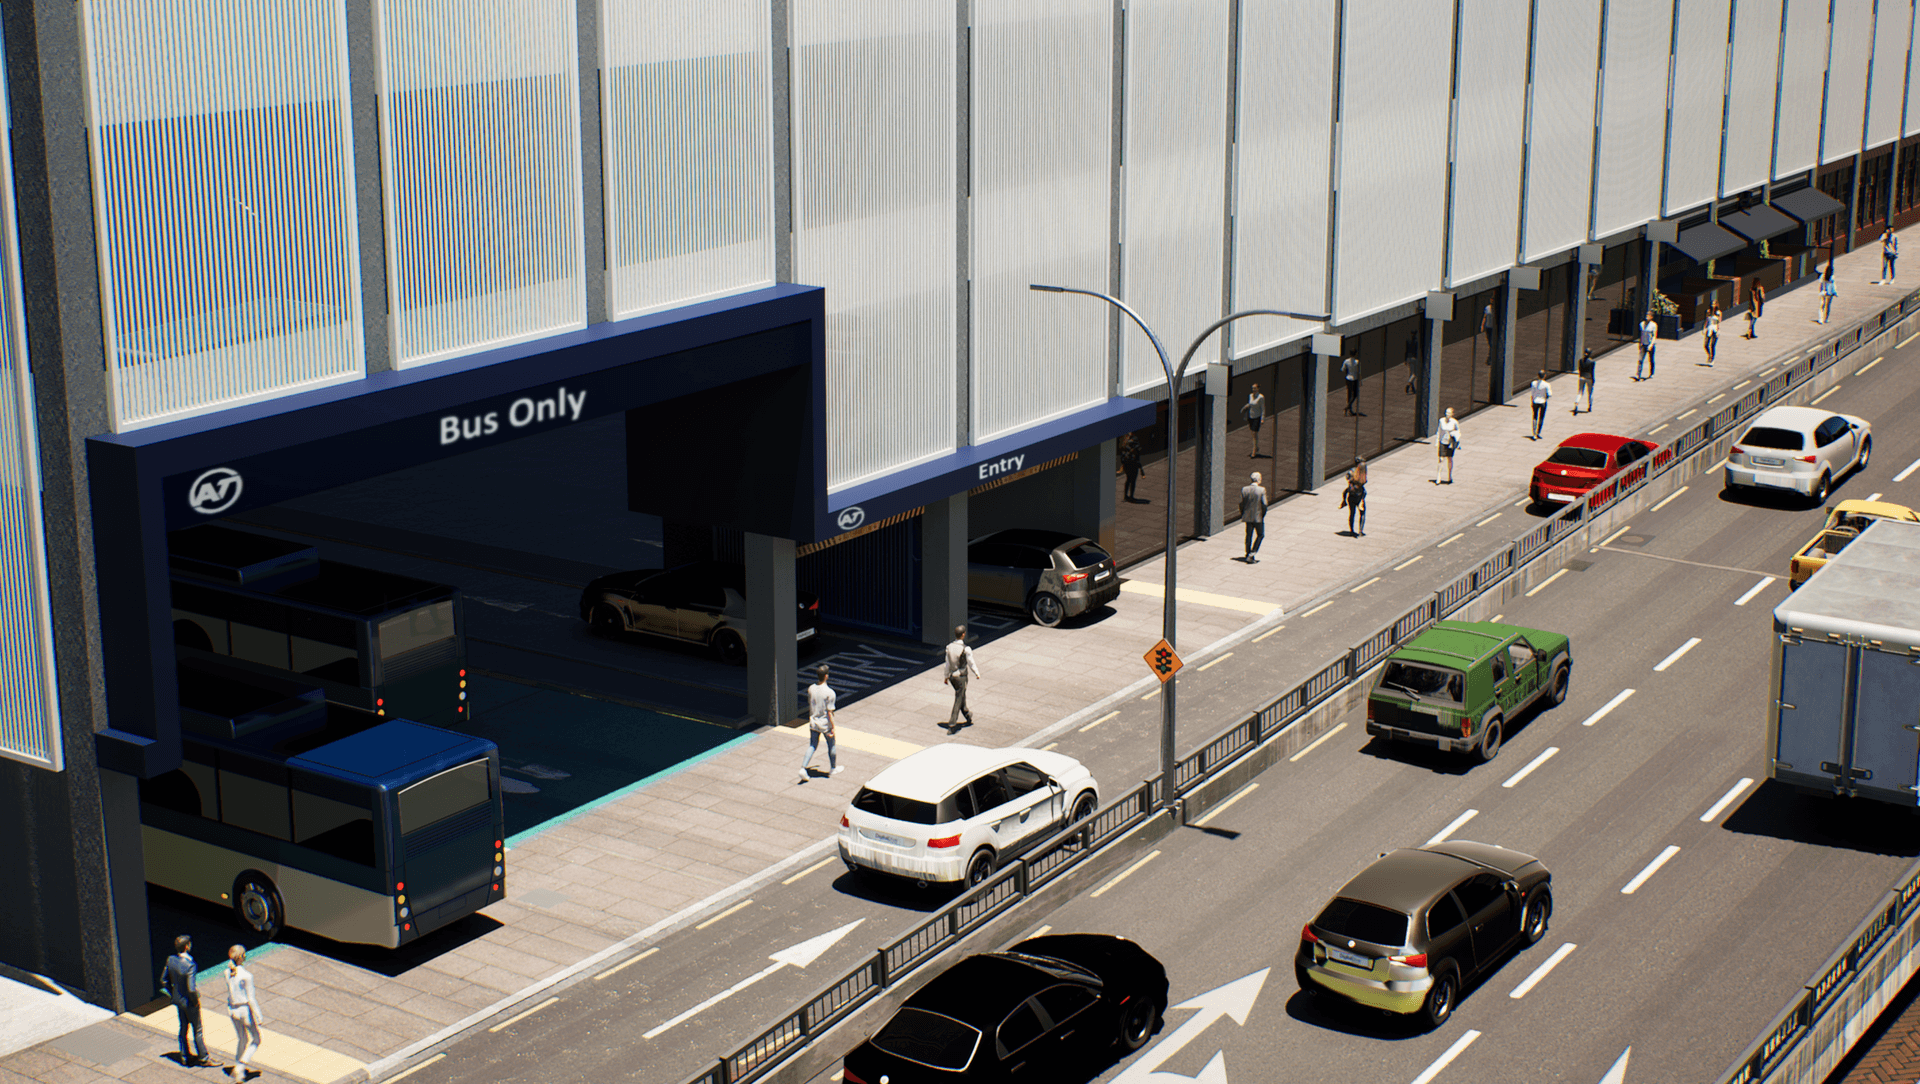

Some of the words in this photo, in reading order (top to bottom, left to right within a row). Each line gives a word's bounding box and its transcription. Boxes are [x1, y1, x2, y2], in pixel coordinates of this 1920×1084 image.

[440, 415, 499, 446] Bus
[508, 386, 587, 428] Only
[978, 453, 1025, 480] Entry
[190, 472, 242, 511] AT
[838, 508, 864, 528] AT
